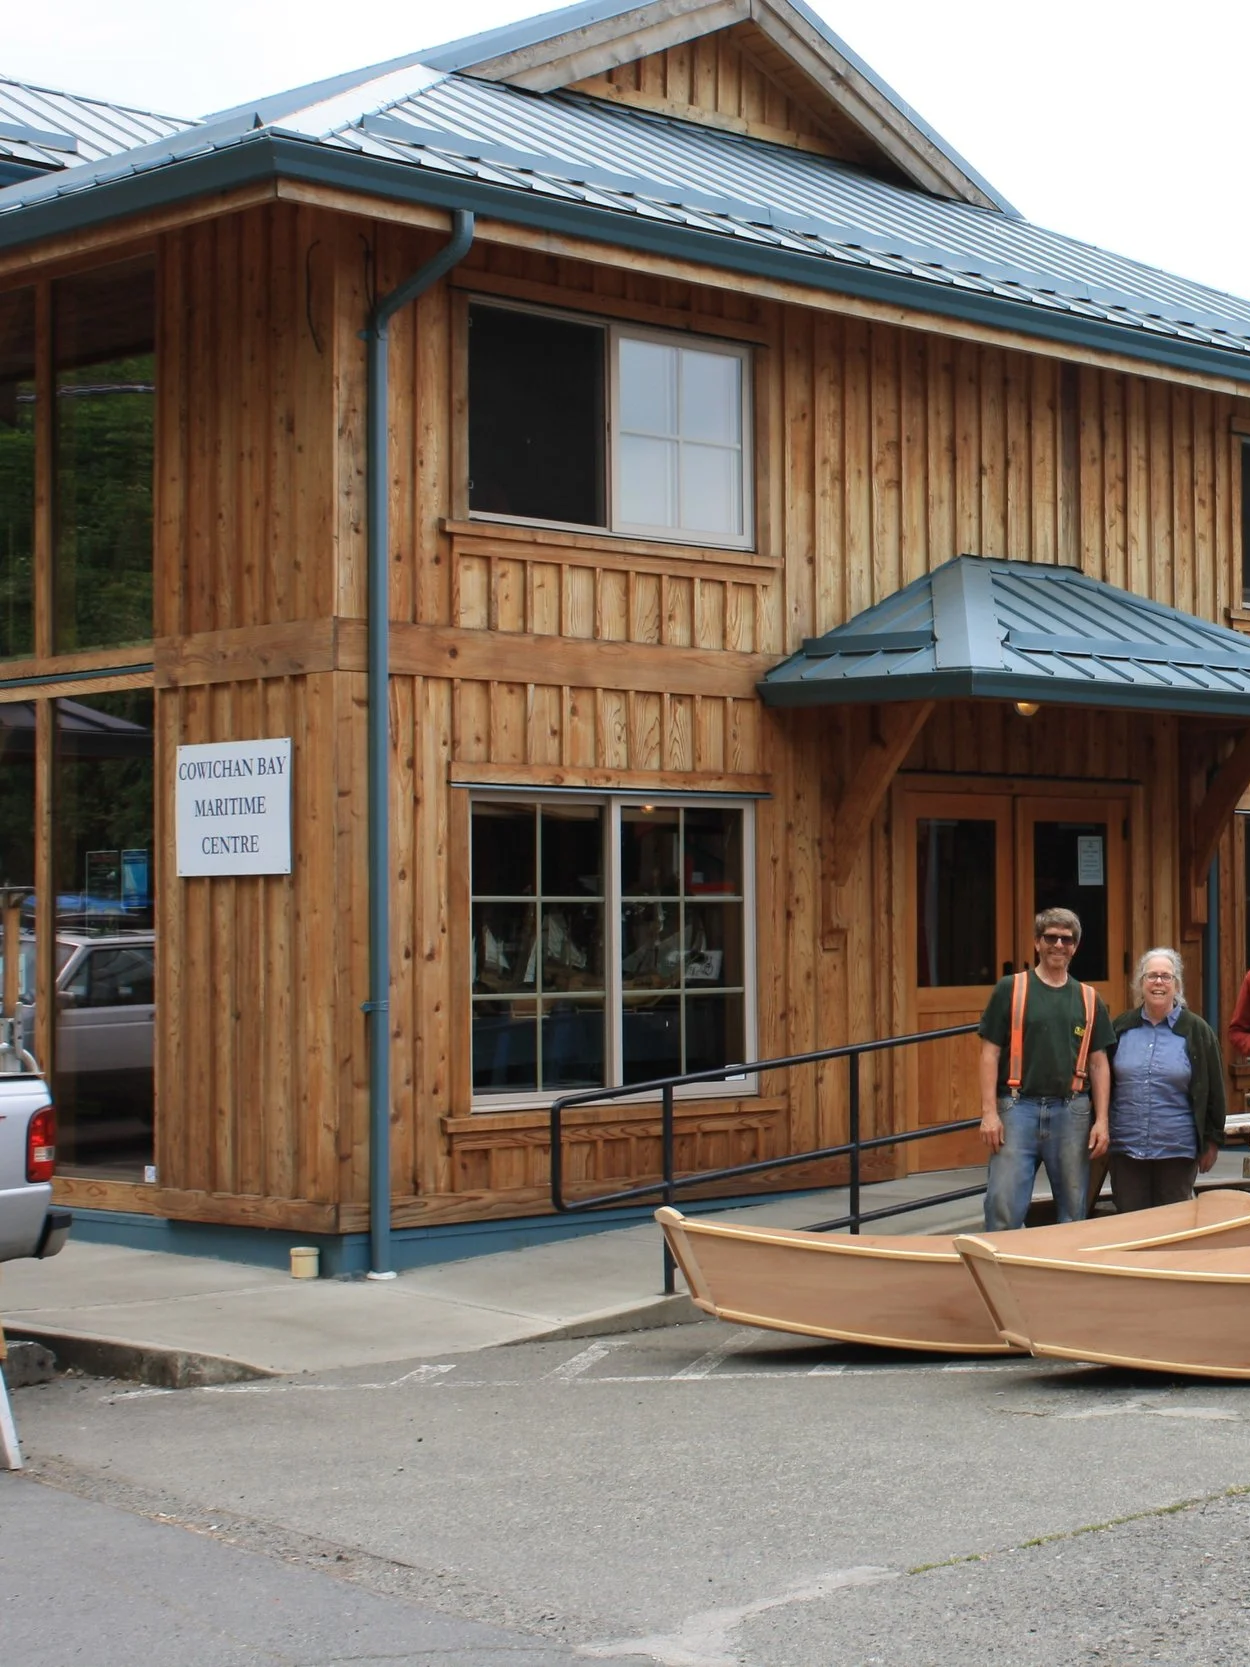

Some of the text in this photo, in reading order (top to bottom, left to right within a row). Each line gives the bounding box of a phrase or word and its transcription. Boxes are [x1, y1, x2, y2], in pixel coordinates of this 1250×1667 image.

[178, 756, 286, 780] COWICHAN BAY
[194, 796, 267, 817] MARITIME
[202, 835, 260, 855] CENTRE
